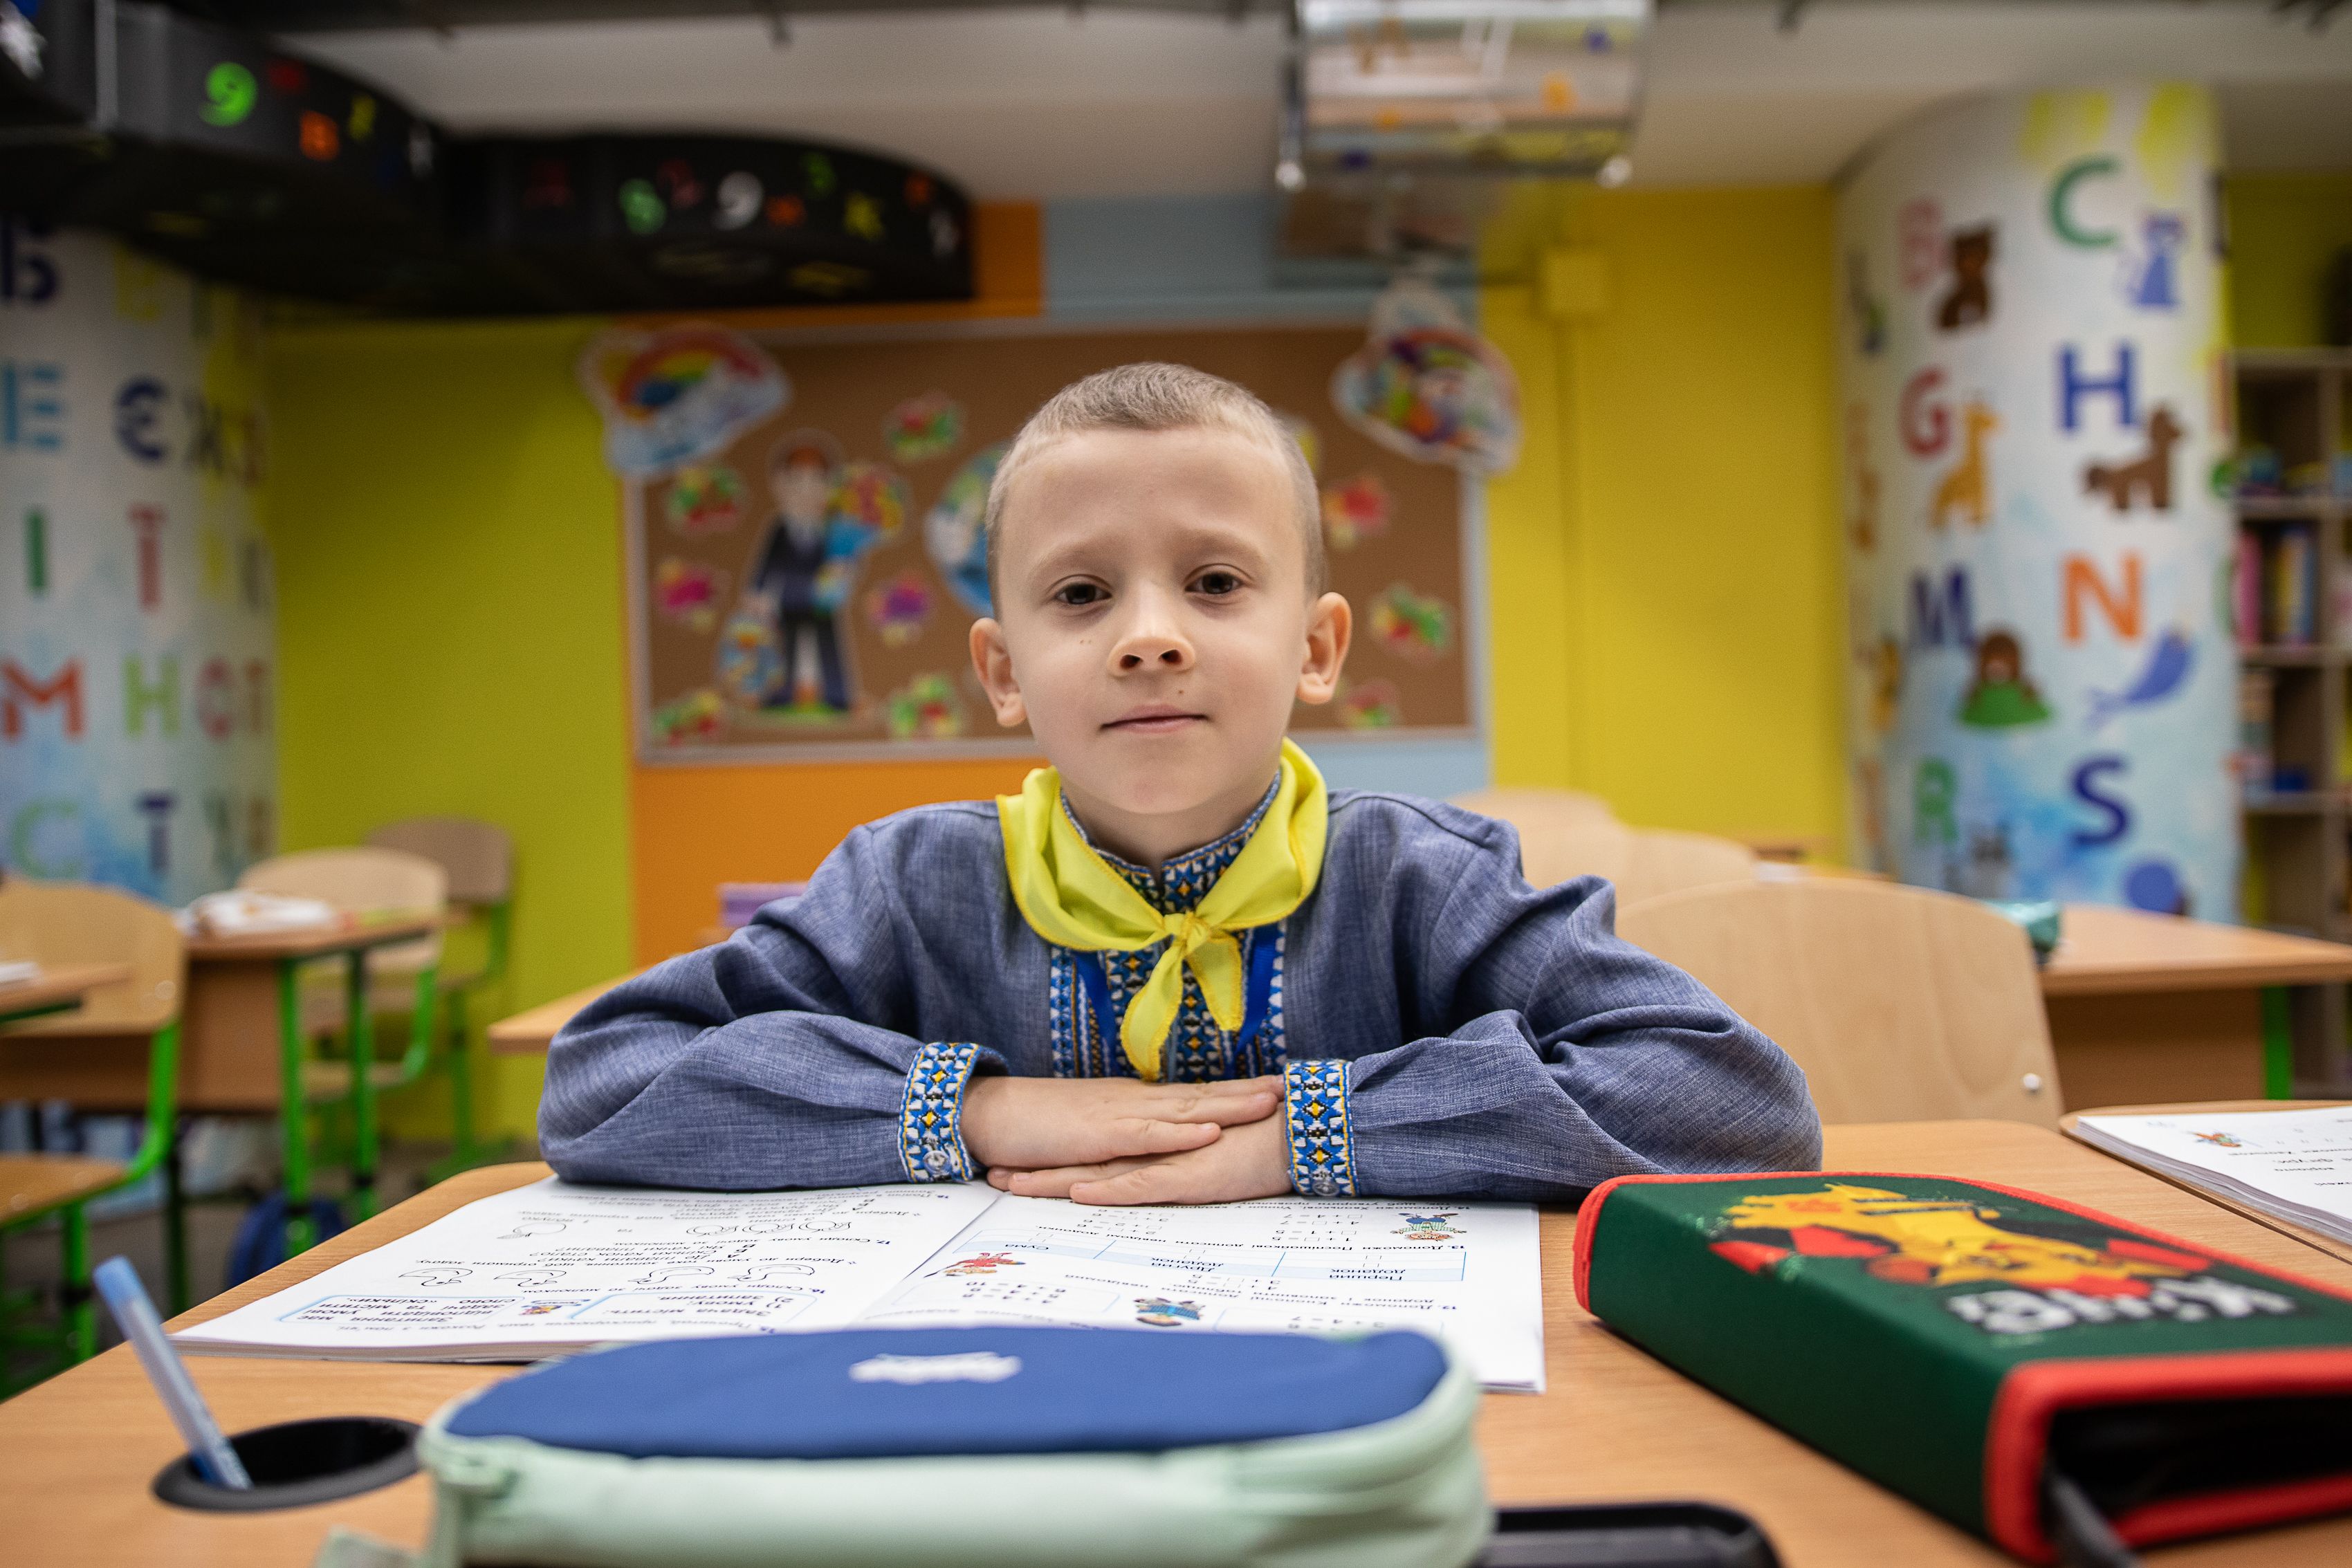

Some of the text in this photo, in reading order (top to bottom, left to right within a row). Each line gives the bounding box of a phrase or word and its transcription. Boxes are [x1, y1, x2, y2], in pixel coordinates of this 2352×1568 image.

[199, 61, 257, 127] 9
[2049, 154, 2120, 247] C
[1898, 339, 2138, 459] G H
[2061, 552, 2140, 641] N
[1, 657, 84, 740] М
[123, 657, 181, 739] Н
[138, 794, 176, 877] Т
[1912, 758, 2133, 847] R S
[1151, 1257, 1224, 1267] доданок
[1151, 1262, 1215, 1272] Другий
